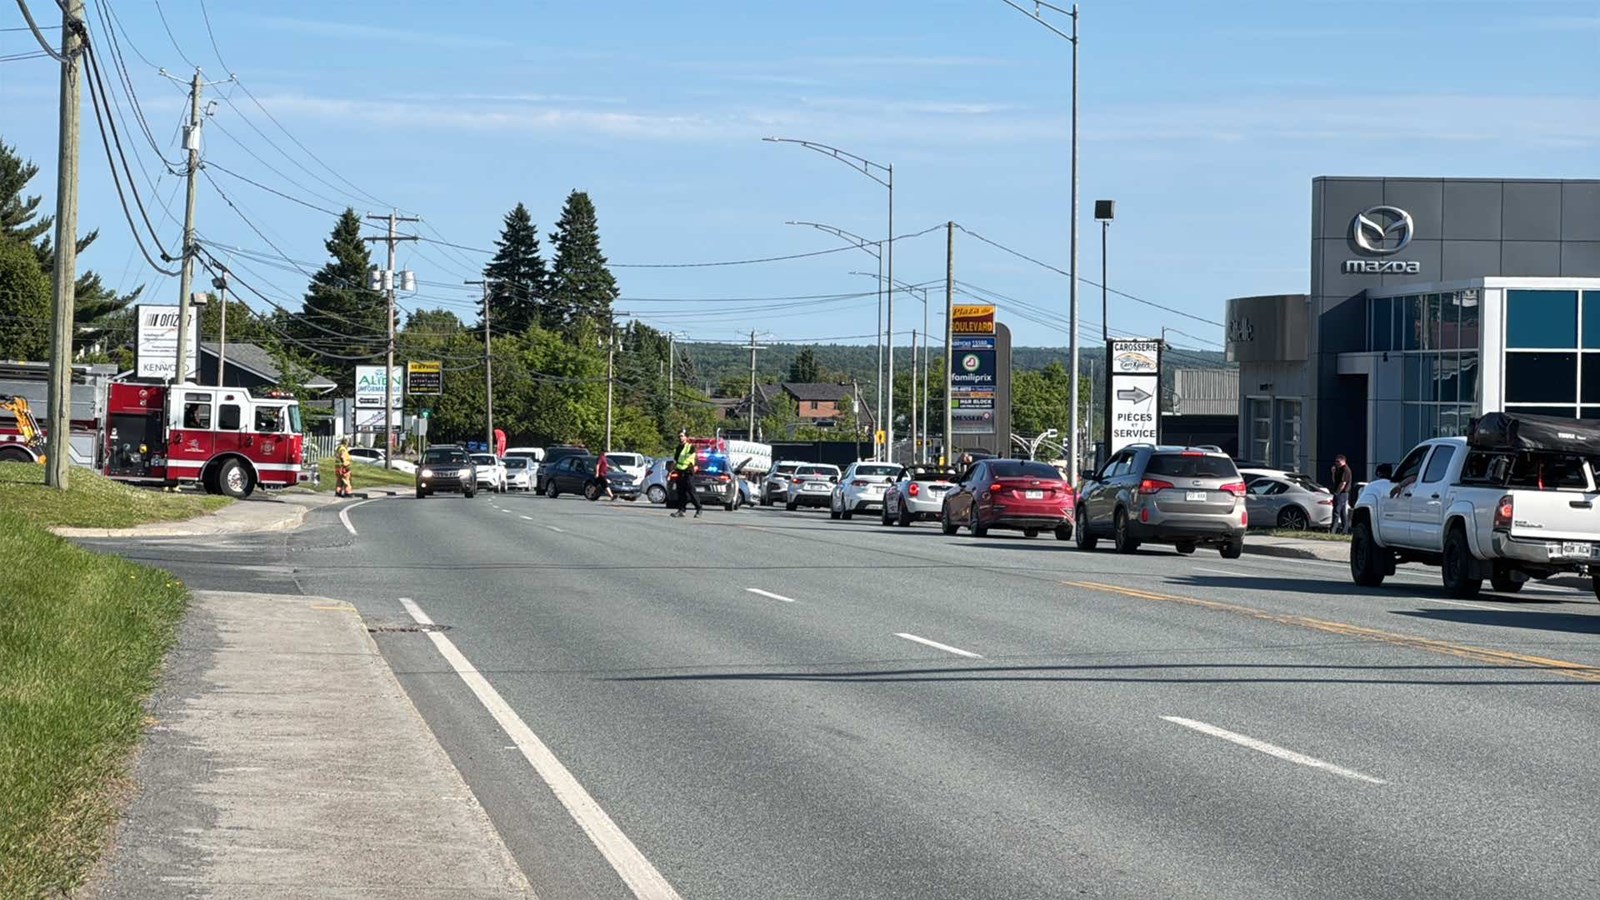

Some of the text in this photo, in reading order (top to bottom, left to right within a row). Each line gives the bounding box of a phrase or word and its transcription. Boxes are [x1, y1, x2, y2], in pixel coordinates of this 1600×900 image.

[1115, 343, 1157, 351] CAROSSERIE
[143, 363, 190, 372] KENWOD
[952, 373, 992, 384] familiprix
[1114, 429, 1156, 438] SERVICE
